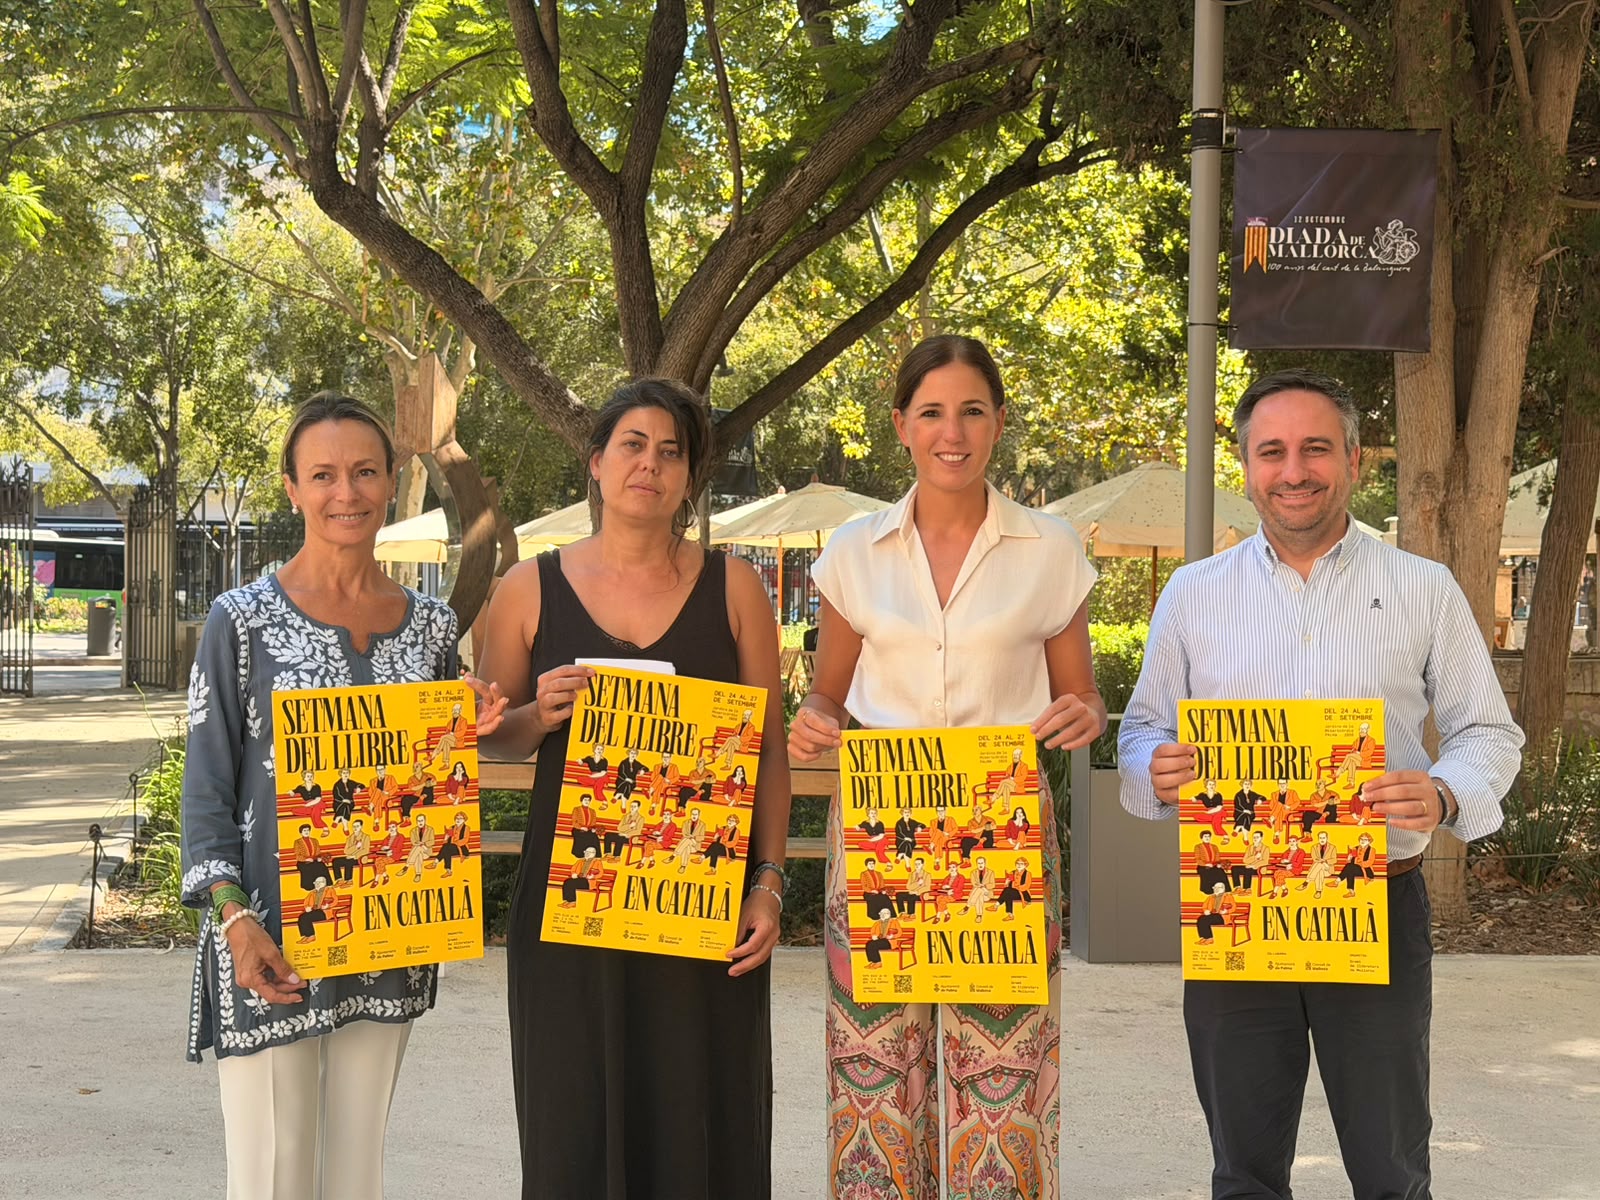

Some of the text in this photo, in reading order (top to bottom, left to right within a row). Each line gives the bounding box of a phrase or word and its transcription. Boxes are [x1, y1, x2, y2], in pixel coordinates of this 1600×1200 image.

[1268, 244, 1378, 259] MALLORCA
[1269, 226, 1366, 245] DIADA DE
[1307, 262, 1319, 271] del
[282, 694, 386, 735] SETMANA
[585, 673, 680, 719] SETMANA
[727, 699, 756, 708] SETEMBRE
[580, 709, 698, 757] DEL LLIBRE
[1186, 708, 1290, 743] SETMANA
[285, 730, 409, 773] DEL LLIBRE
[847, 736, 947, 773] SETMANA
[1193, 746, 1313, 780] DEL LLIBRE
[851, 773, 969, 809] DEL LLIBRE
[363, 880, 474, 930] EN CATALÀ
[623, 875, 731, 921] EN CATALÀ
[1262, 902, 1379, 943] EN CATALÀ
[927, 925, 1038, 965] EN CATALÀ
